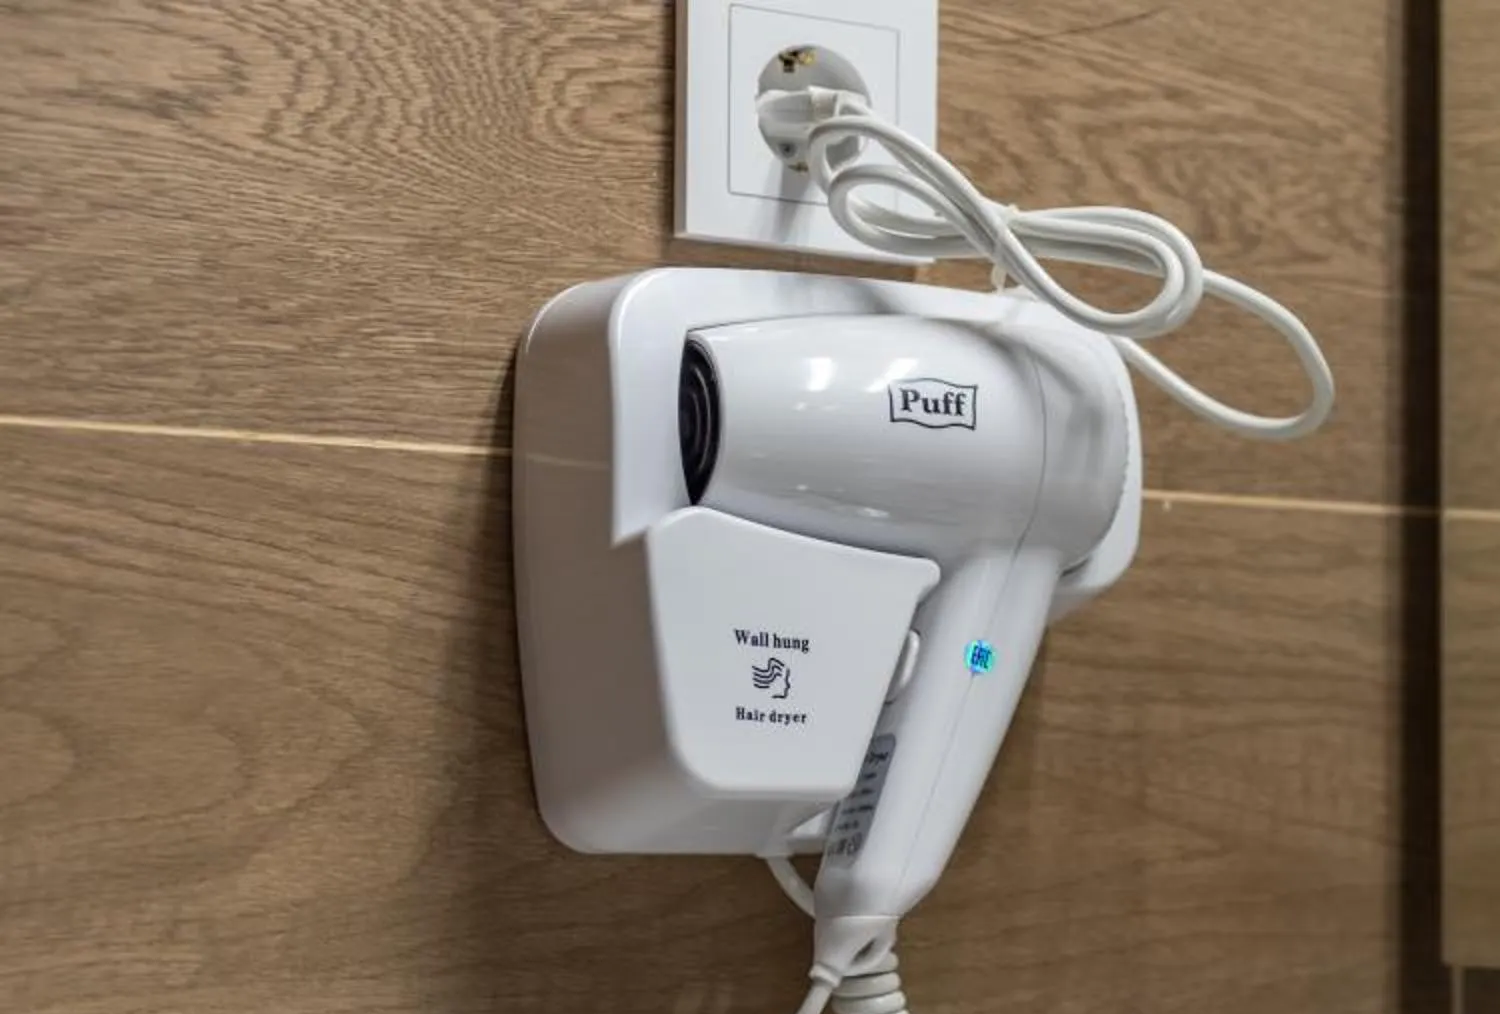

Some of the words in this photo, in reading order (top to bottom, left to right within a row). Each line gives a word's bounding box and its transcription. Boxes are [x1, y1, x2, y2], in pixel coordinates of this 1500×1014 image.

[899, 388, 967, 416] Puff
[734, 628, 769, 648] Wall
[772, 632, 810, 654] hung
[735, 705, 765, 722] Hair
[768, 709, 807, 726] dryer
